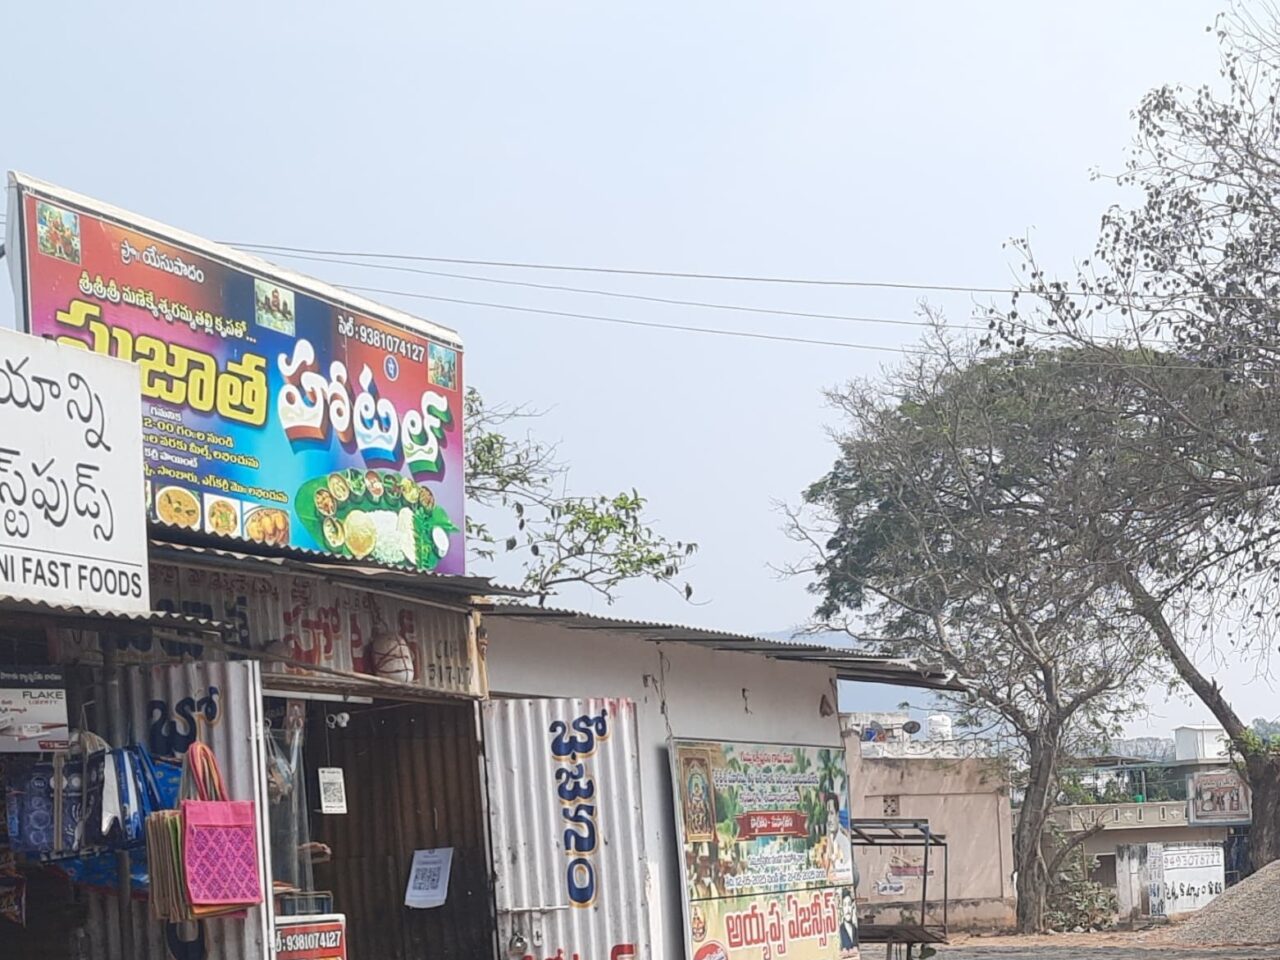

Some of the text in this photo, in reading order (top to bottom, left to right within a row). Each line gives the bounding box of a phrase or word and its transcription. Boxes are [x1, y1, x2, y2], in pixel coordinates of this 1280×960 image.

[278, 339, 448, 470] హోటల్
[22, 556, 71, 589] FAST
[78, 563, 142, 599] FOODS
[22, 690, 64, 700] FLAKE
